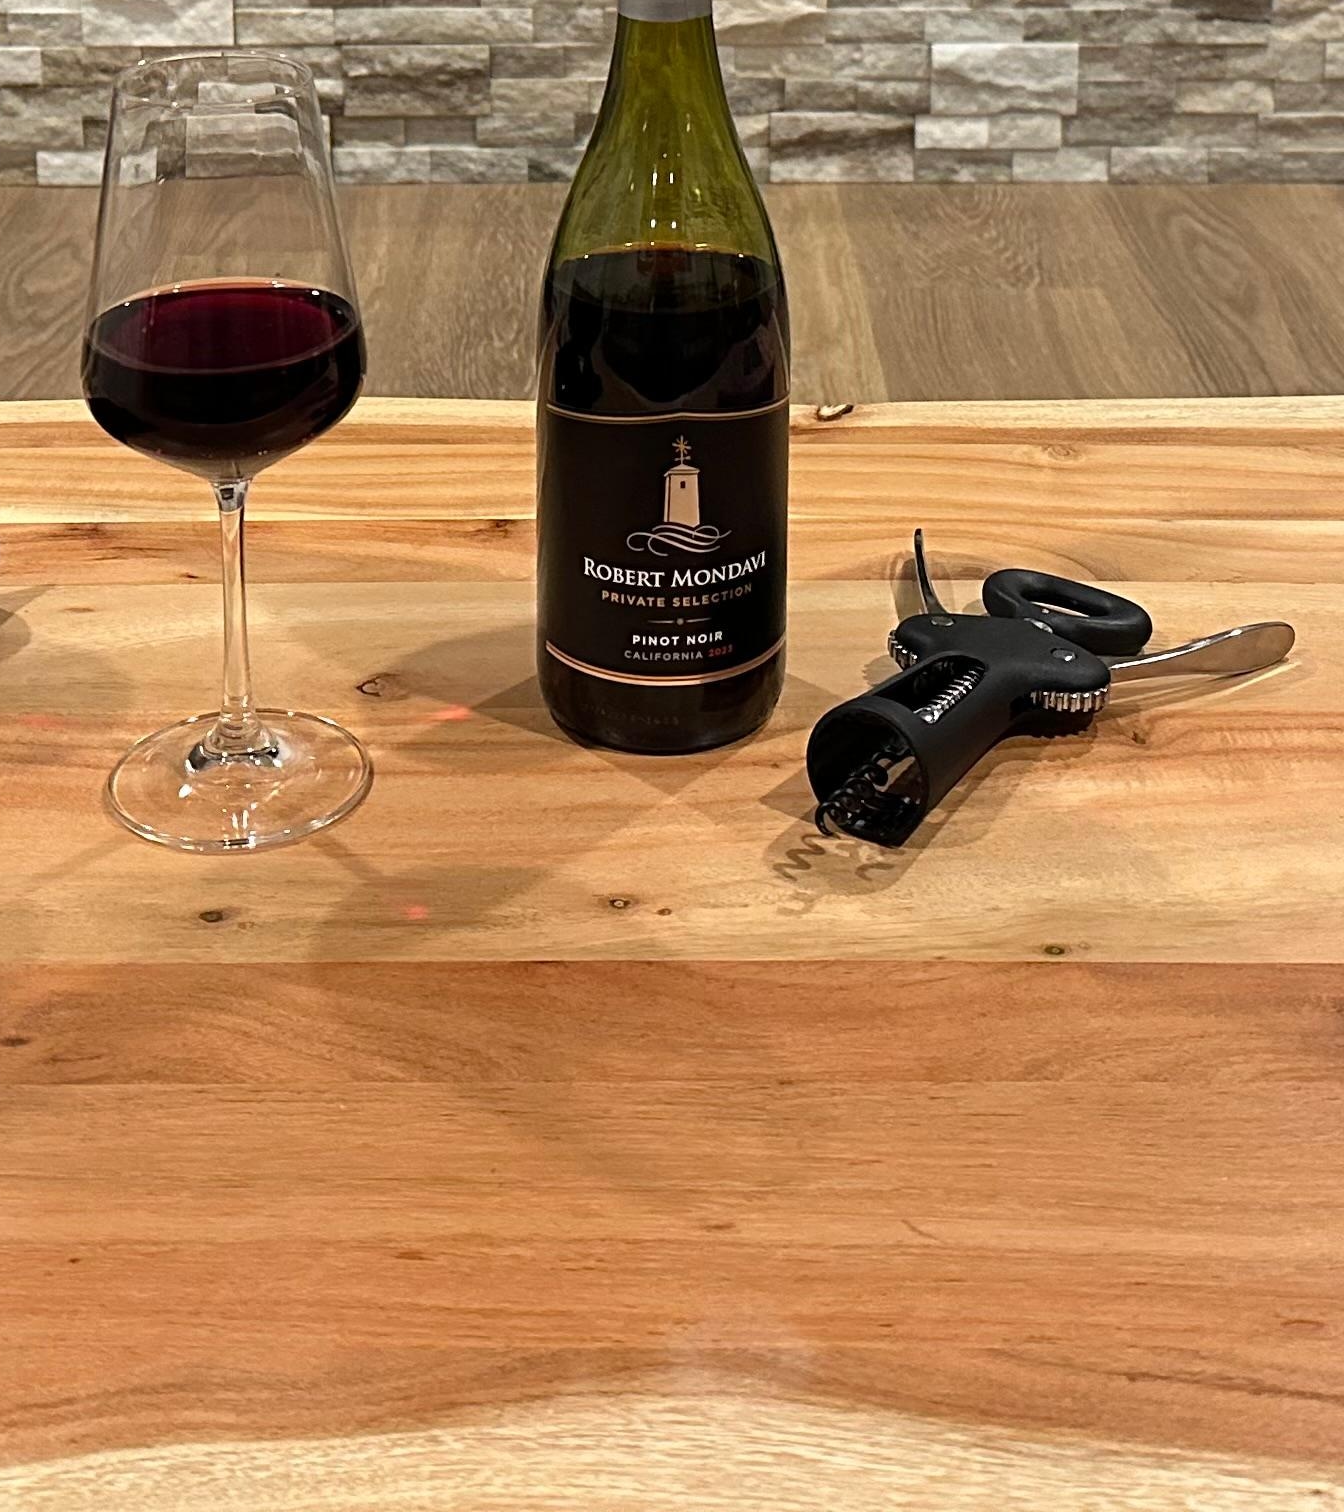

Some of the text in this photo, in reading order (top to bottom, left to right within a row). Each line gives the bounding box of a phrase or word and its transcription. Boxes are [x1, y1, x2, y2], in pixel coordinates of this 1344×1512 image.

[583, 550, 767, 588] ROBERT MONDAVI
[601, 583, 753, 608] PRIVATE SELECTION
[632, 630, 723, 647] PINOT NOIR
[624, 649, 704, 662] CALIFORNIA
